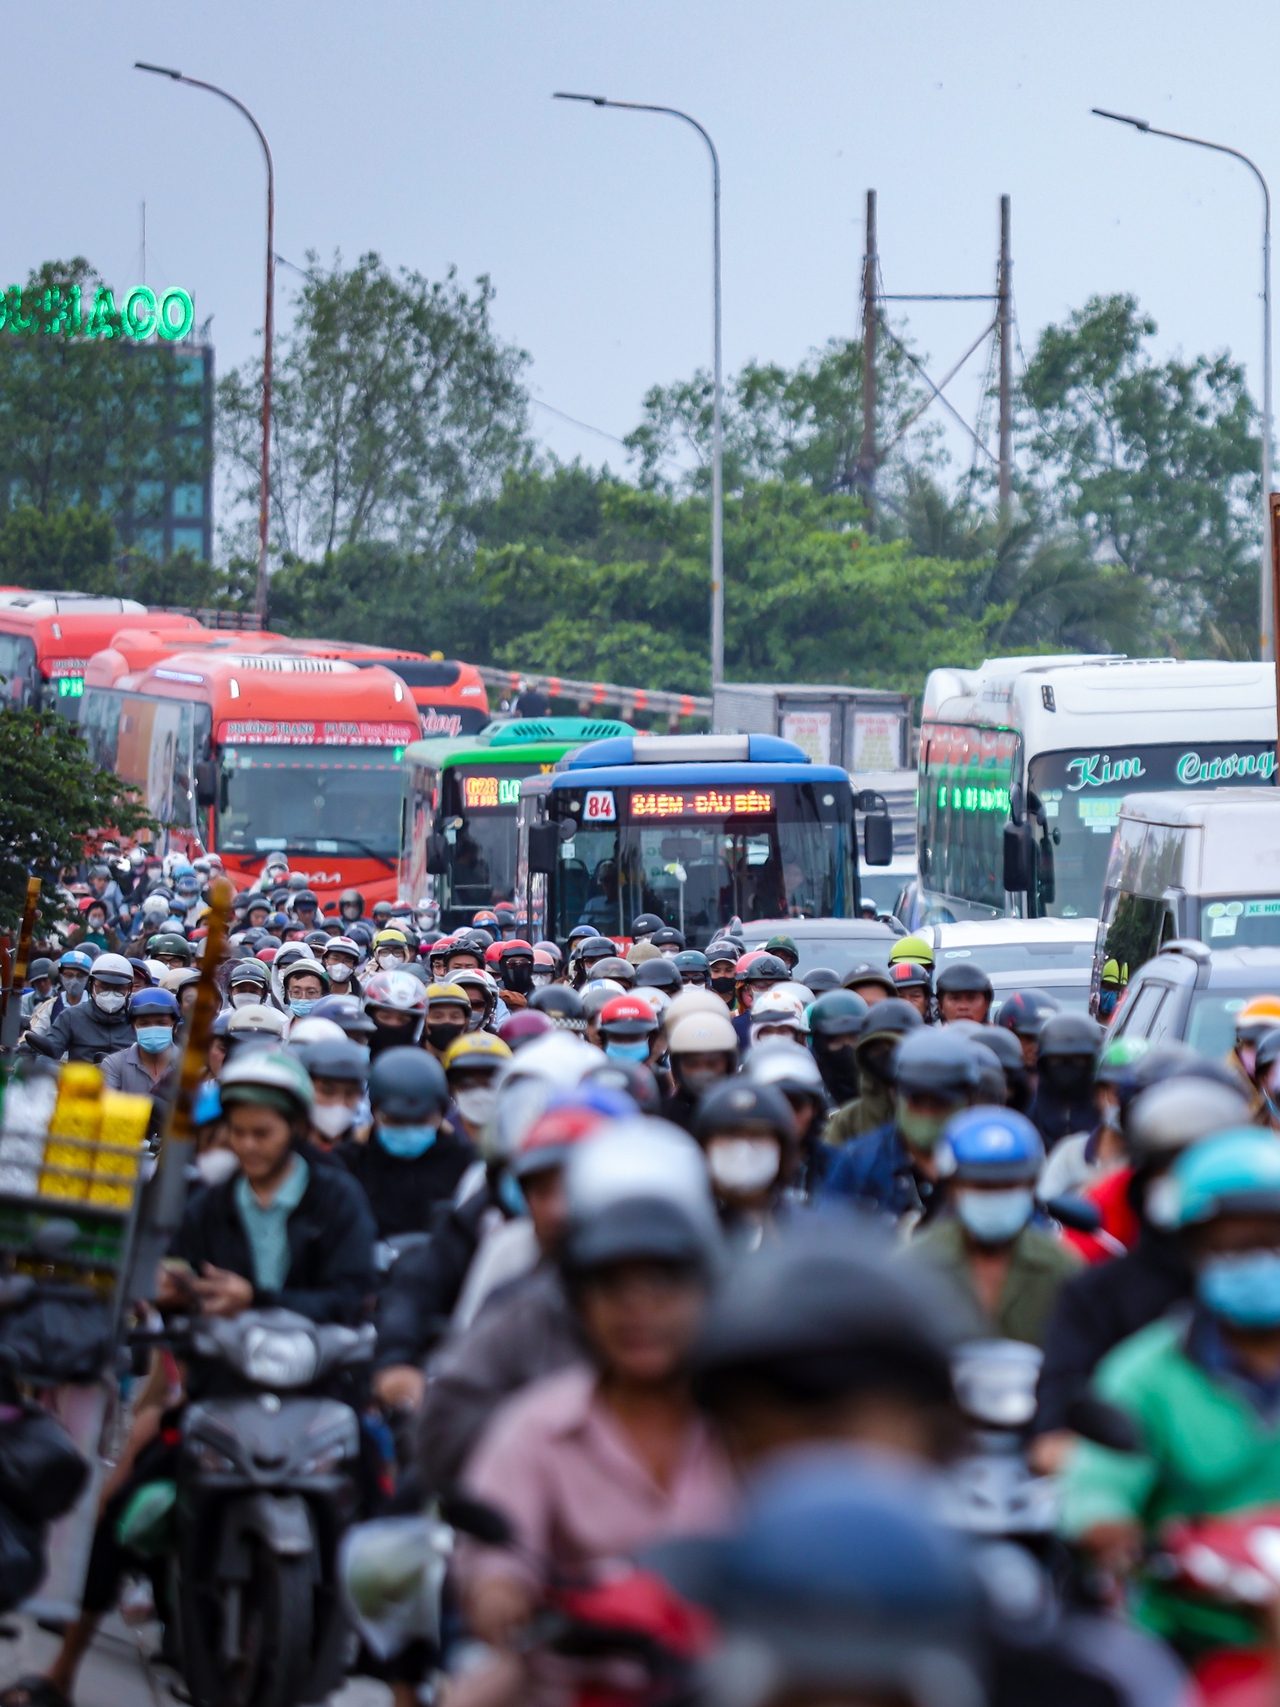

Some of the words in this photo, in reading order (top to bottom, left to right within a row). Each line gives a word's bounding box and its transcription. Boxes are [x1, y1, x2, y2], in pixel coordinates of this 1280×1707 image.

[1066, 752, 1147, 792] Kim
[1176, 750, 1280, 785] Cương
[588, 796, 613, 818] 84
[733, 789, 772, 813] BẾN
[1249, 905, 1261, 913] XE
